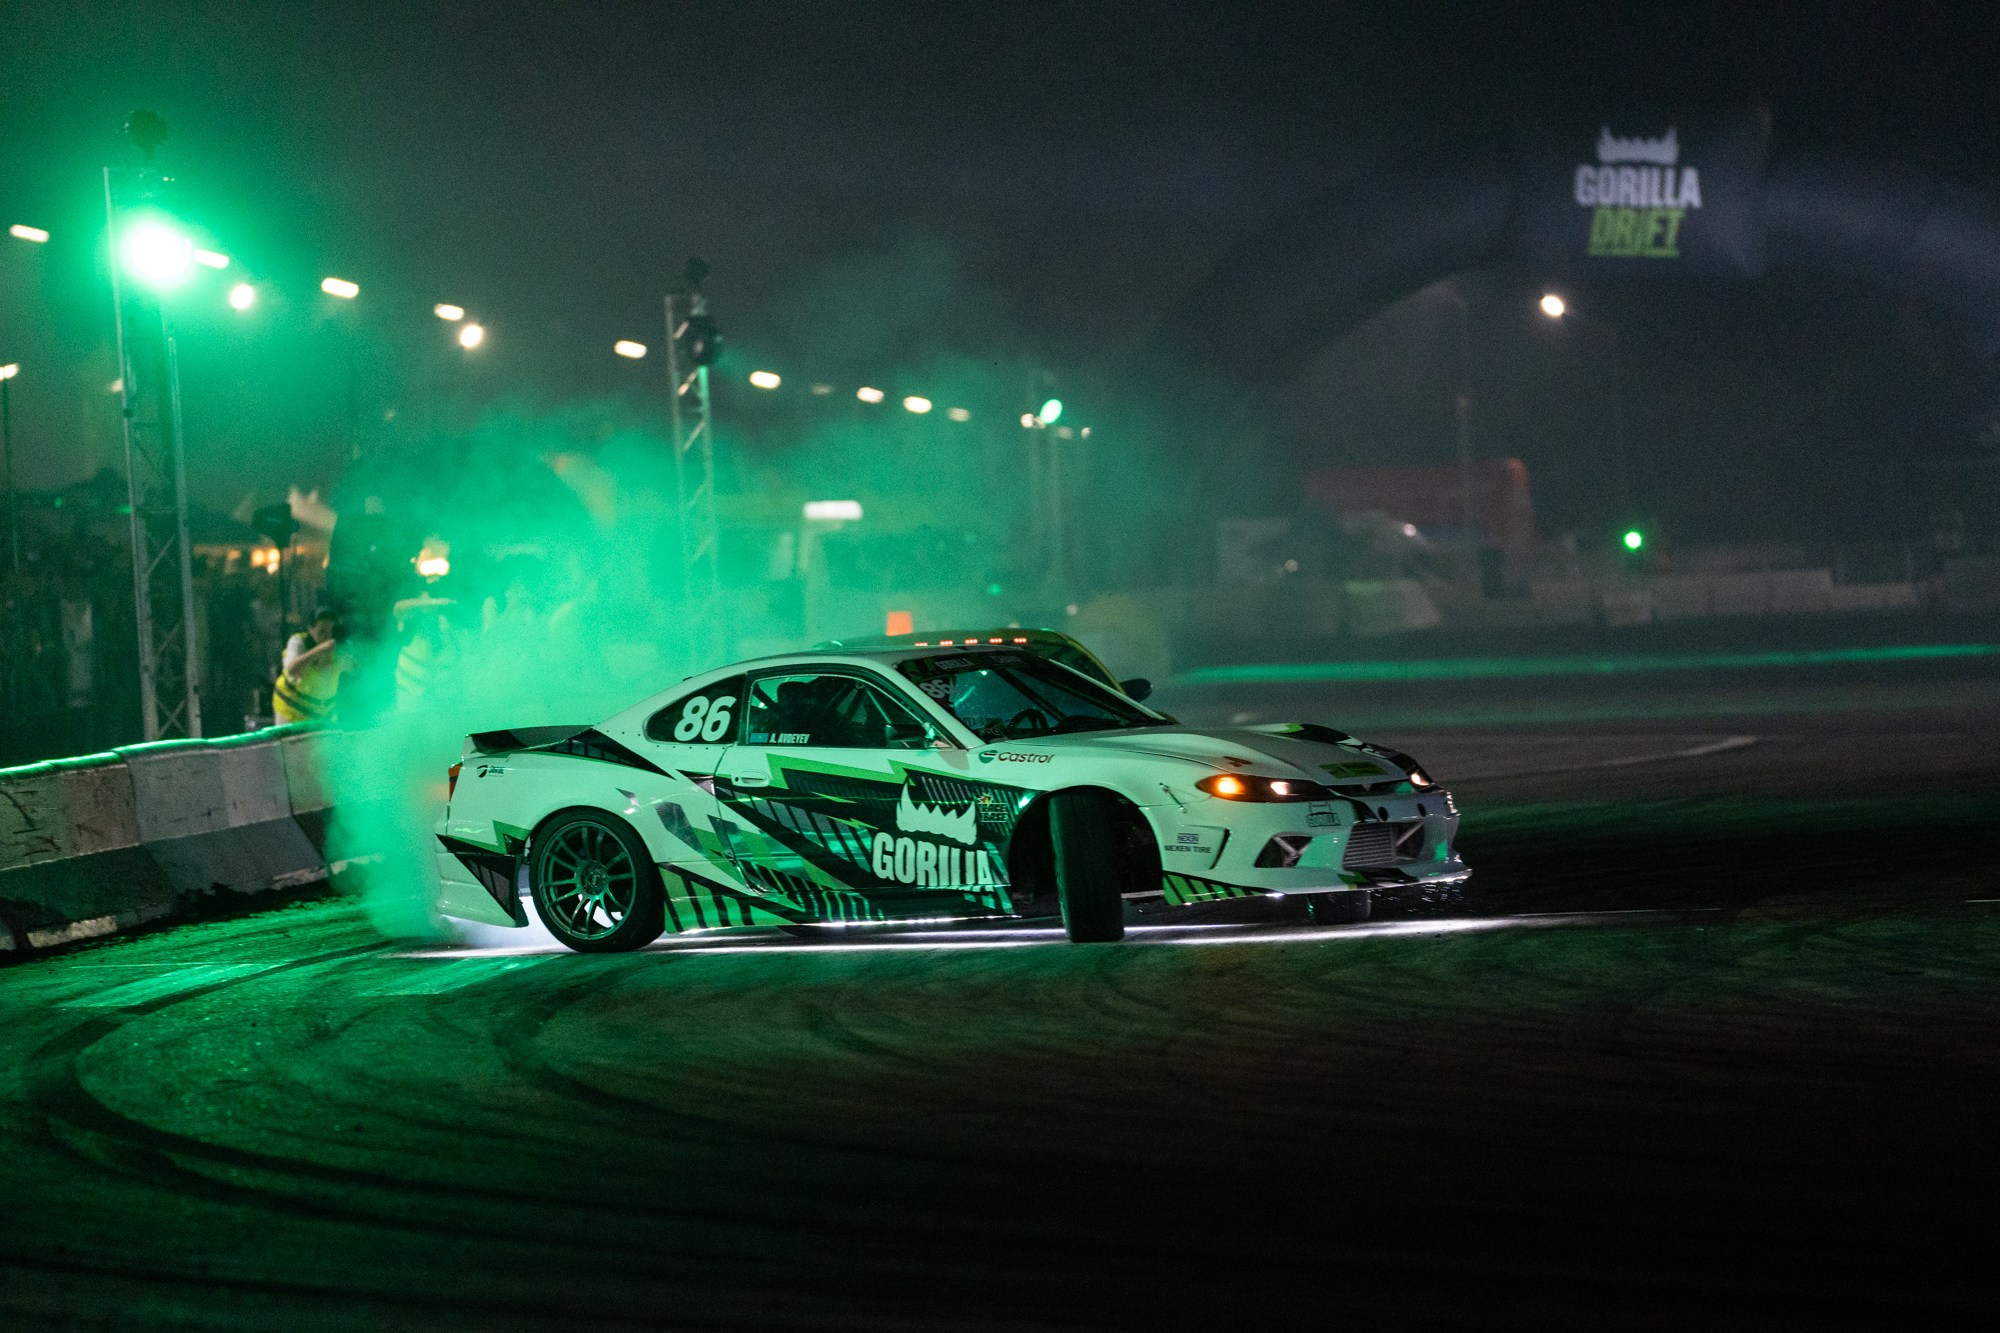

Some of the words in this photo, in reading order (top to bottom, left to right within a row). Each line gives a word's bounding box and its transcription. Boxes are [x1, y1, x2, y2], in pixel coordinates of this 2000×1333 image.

[1574, 164, 1702, 208] GORILLA
[1588, 207, 1686, 258] DRIFT
[674, 696, 737, 742] 86
[997, 750, 1055, 764] Castrol
[872, 832, 995, 893] GORILLA
